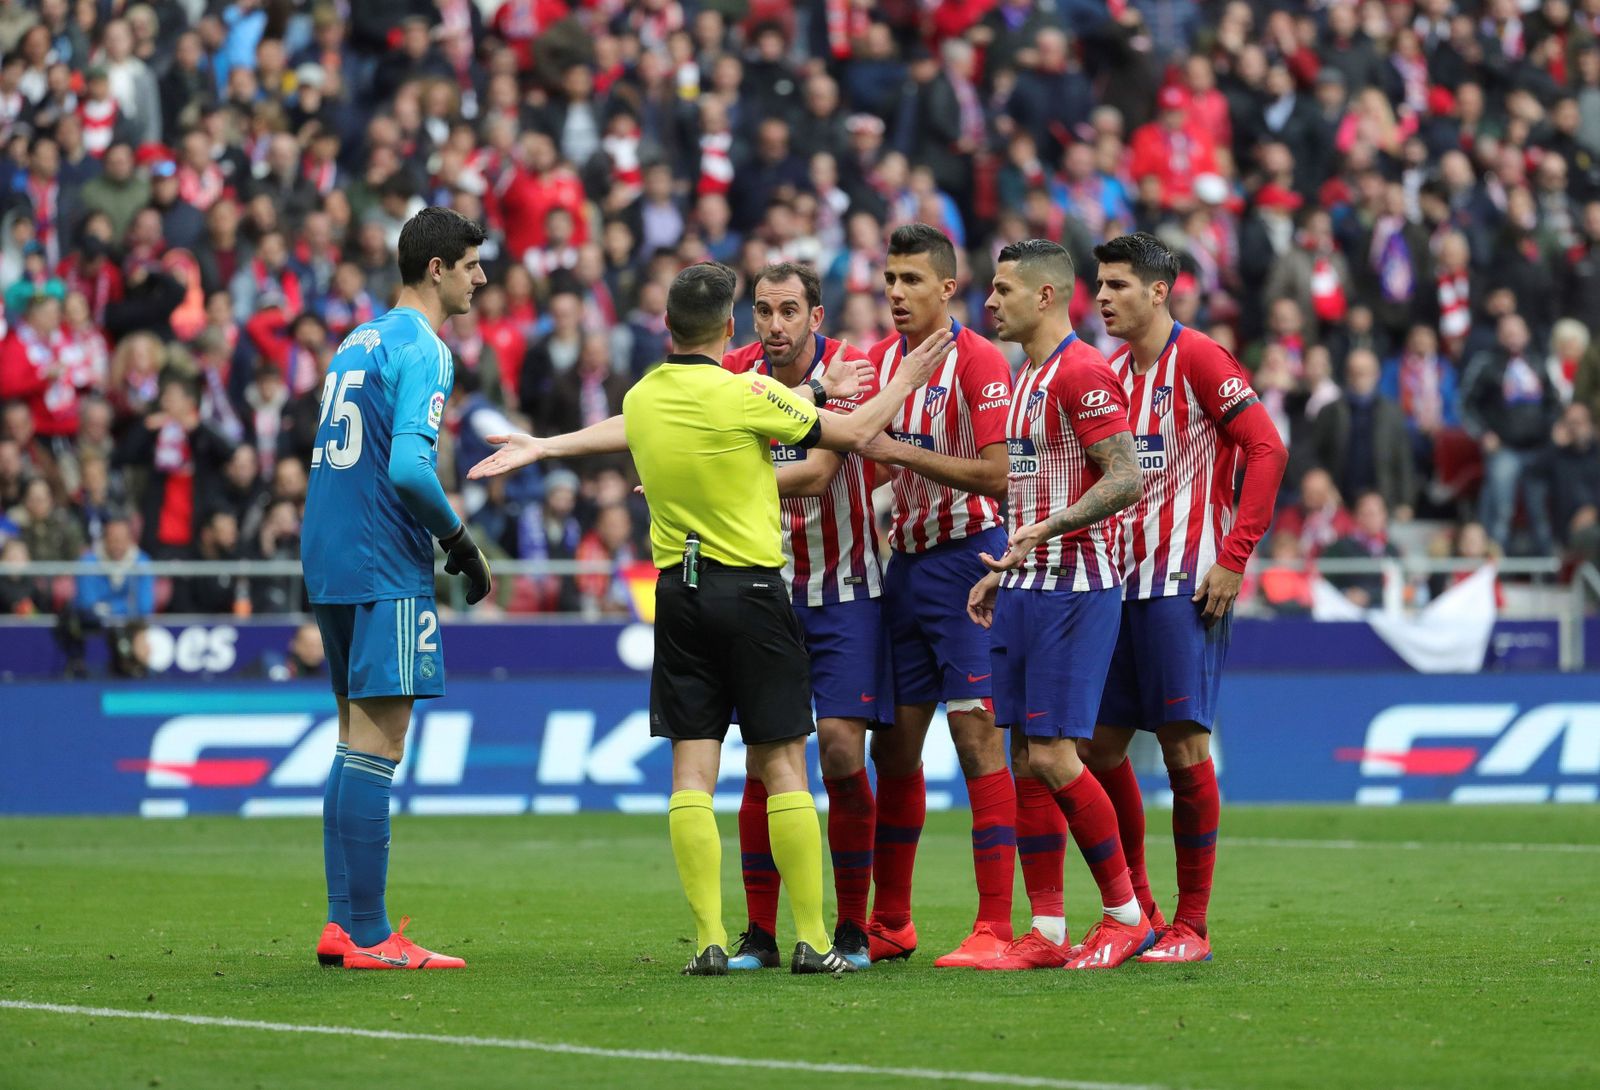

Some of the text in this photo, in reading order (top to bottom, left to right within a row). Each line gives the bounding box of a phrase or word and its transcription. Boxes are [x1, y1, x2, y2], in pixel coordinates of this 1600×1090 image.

[767, 391, 809, 424] WÜRTH
[1078, 404, 1119, 419] HYUNDAI
[417, 610, 437, 652] 2
